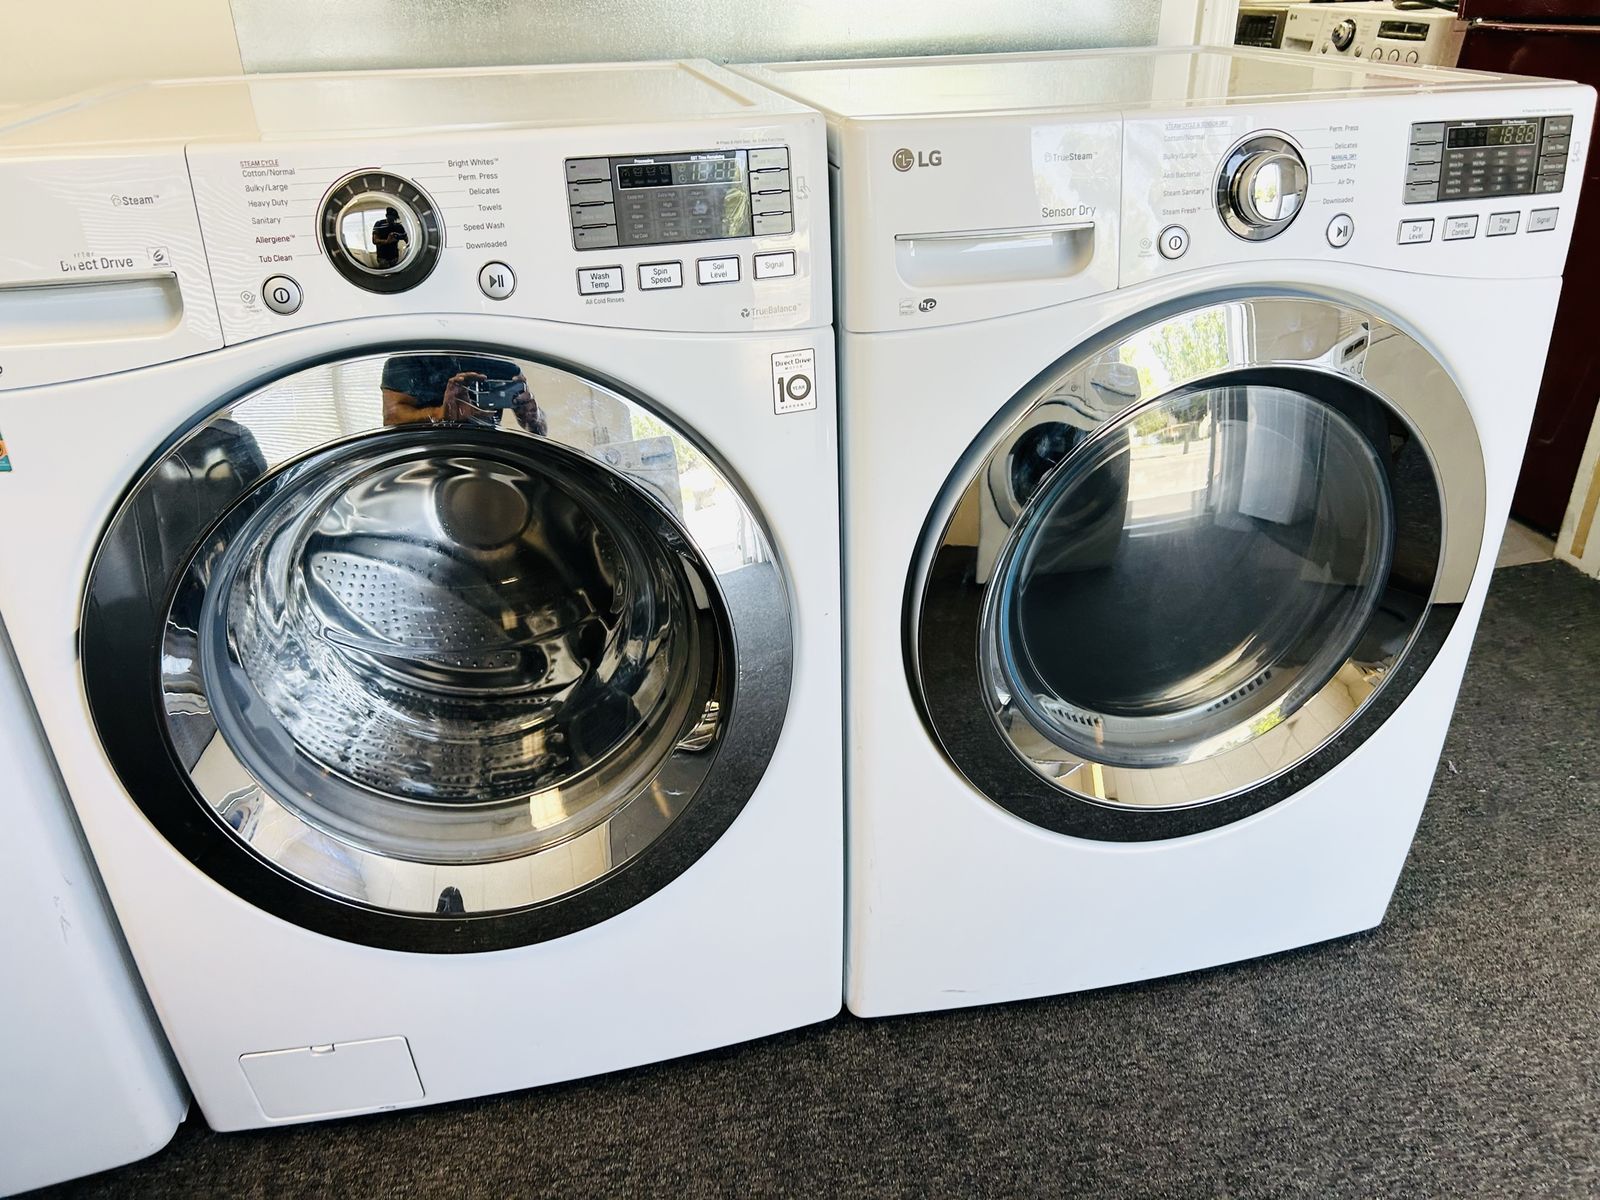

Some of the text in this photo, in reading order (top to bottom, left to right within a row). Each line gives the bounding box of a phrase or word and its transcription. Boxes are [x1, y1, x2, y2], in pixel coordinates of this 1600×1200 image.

[448, 159, 469, 168] Bright
[918, 150, 942, 168] LG
[240, 160, 260, 168] STEAM
[242, 168, 296, 178] Cotton/Normal
[479, 172, 498, 180] Press
[245, 183, 289, 193] Bulky/Large
[247, 198, 289, 208] Heavy Duty
[1041, 204, 1096, 218] Sensor Dry
[1163, 208, 1180, 216] Steam
[251, 216, 281, 225] Sanitary
[463, 222, 505, 232] Speed Wash
[465, 240, 508, 250] Downloaded
[100, 257, 134, 269] Drive
[259, 254, 293, 263] Tub Clean
[712, 262, 725, 271] Soil
[764, 260, 785, 270] Signal
[590, 272, 610, 280] Wash
[652, 267, 669, 276] Spin
[710, 271, 728, 279] Level
[590, 280, 610, 289] Temp
[650, 275, 672, 285] Speed
[593, 297, 606, 305] Cold
[777, 373, 812, 403] 10
